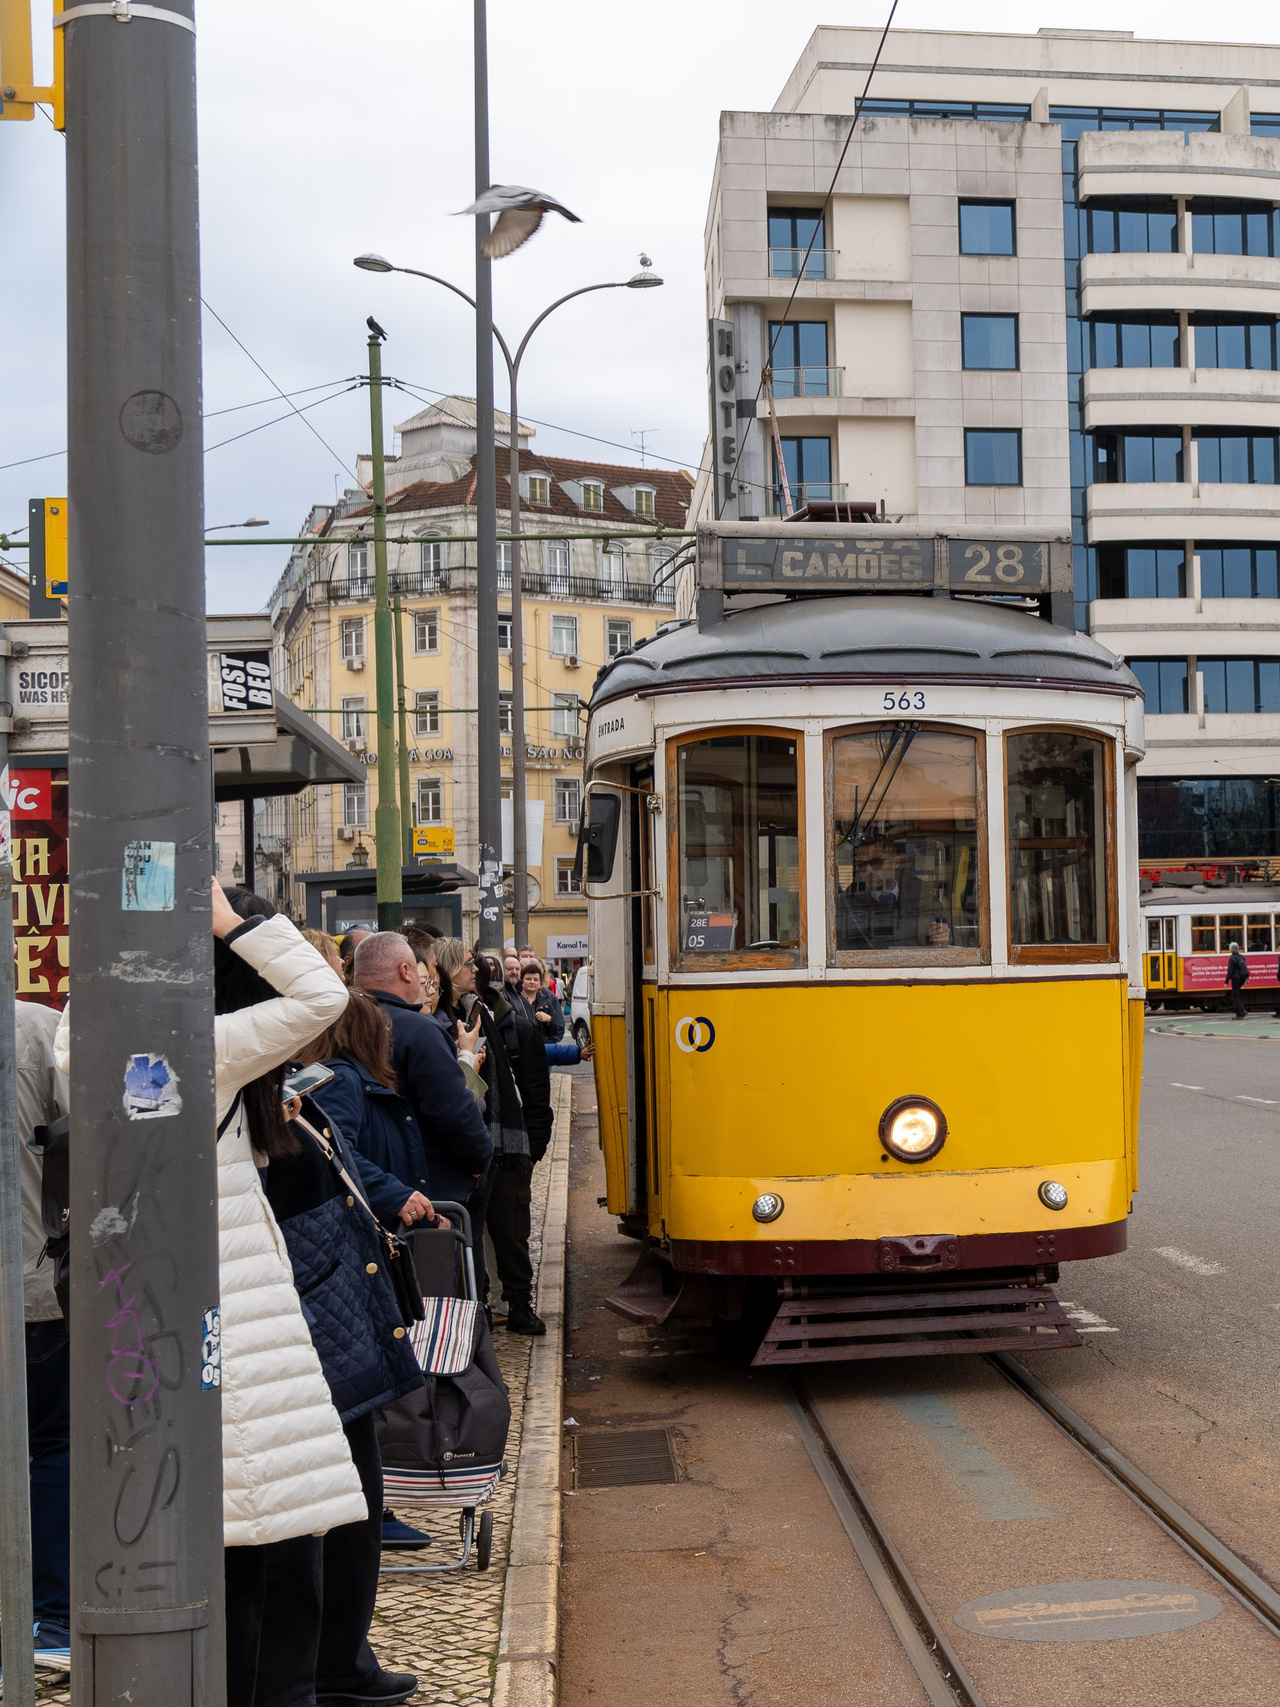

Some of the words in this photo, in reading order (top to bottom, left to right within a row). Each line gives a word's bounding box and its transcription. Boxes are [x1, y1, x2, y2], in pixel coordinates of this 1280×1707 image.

[718, 328, 737, 500] HOTEL
[737, 549, 762, 576] L.
[782, 550, 923, 580] CAMÕES
[964, 544, 1025, 583] 28
[220, 654, 248, 710] FOST
[246, 661, 273, 706] BEO
[19, 691, 48, 703] WAS
[883, 691, 926, 711] 563
[598, 717, 625, 738] ENTRADA
[424, 748, 454, 761] GOA
[690, 918, 708, 927] 28E
[557, 941, 577, 949] Kamal
[688, 935, 706, 947] 05
